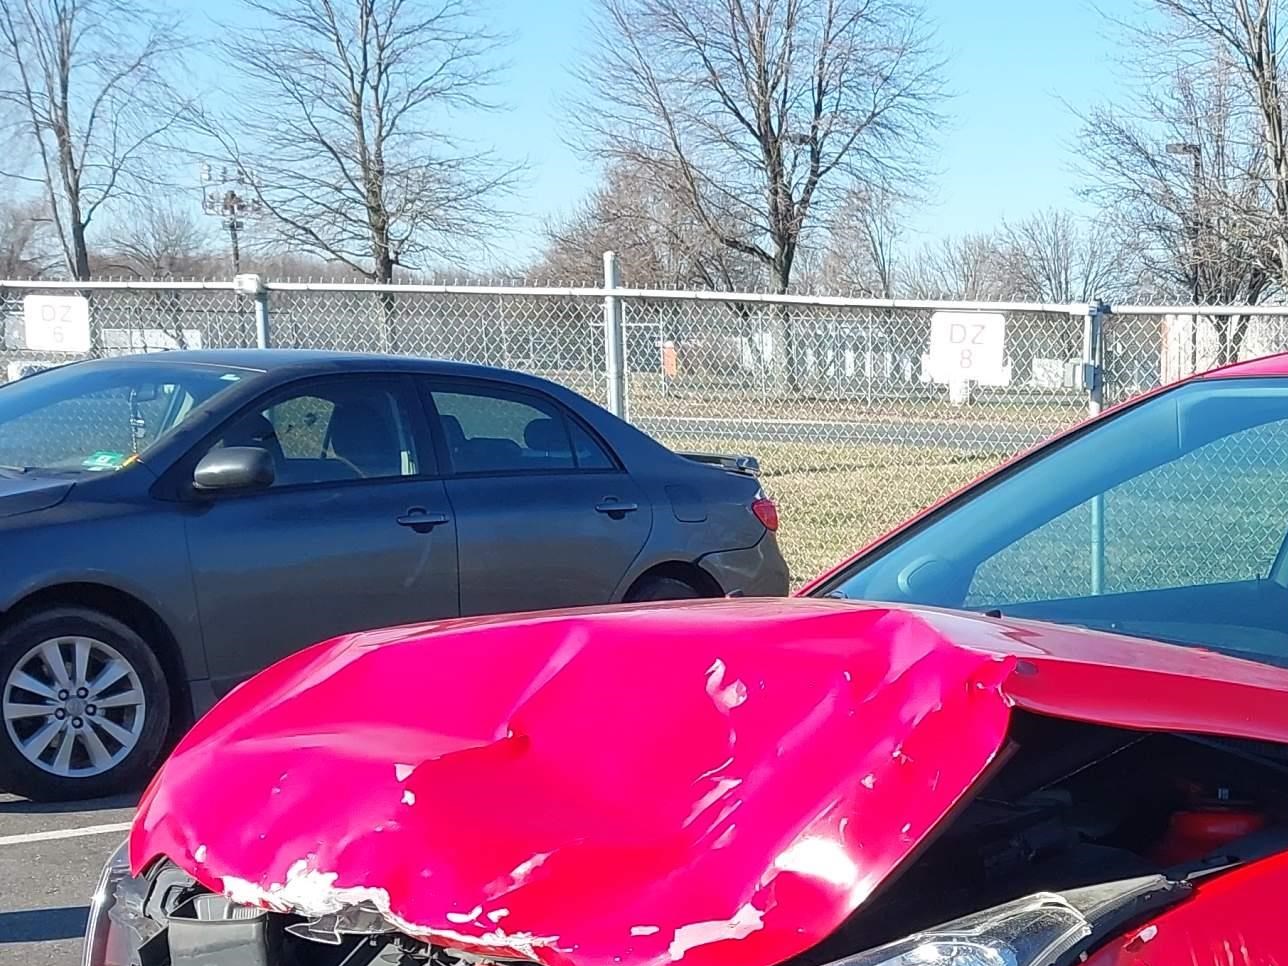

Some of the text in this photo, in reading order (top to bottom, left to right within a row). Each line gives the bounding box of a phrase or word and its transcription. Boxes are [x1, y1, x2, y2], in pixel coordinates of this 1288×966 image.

[41, 304, 73, 323] DZ
[950, 323, 985, 344] DZ
[960, 349, 972, 368] 8
